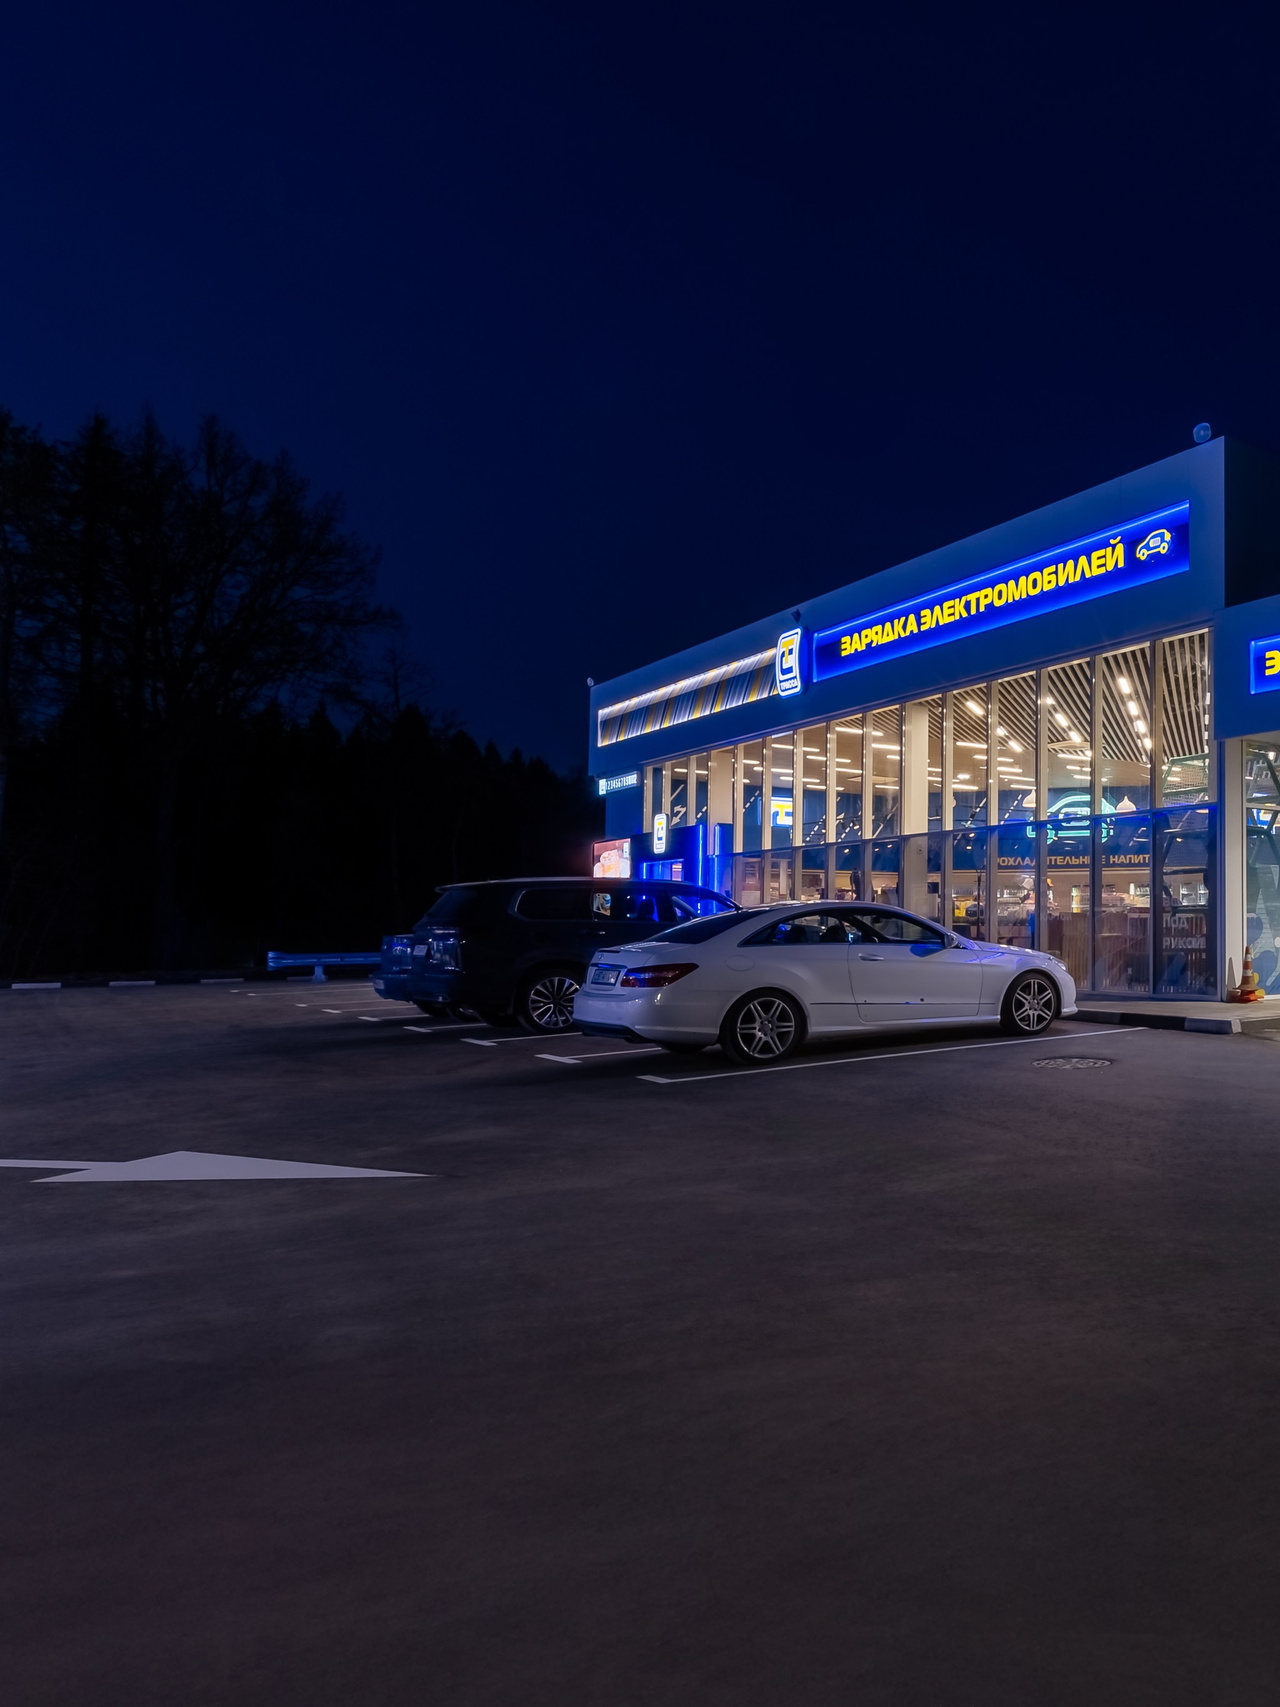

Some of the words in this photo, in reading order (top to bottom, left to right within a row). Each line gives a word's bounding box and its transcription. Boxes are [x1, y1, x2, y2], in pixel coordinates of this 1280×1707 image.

[841, 613, 918, 657] ЗАРЯДКА
[920, 536, 1125, 632] ЭЛЕКТРОМОБИЛЕЙ
[1109, 854, 1150, 865] НАПИТ
